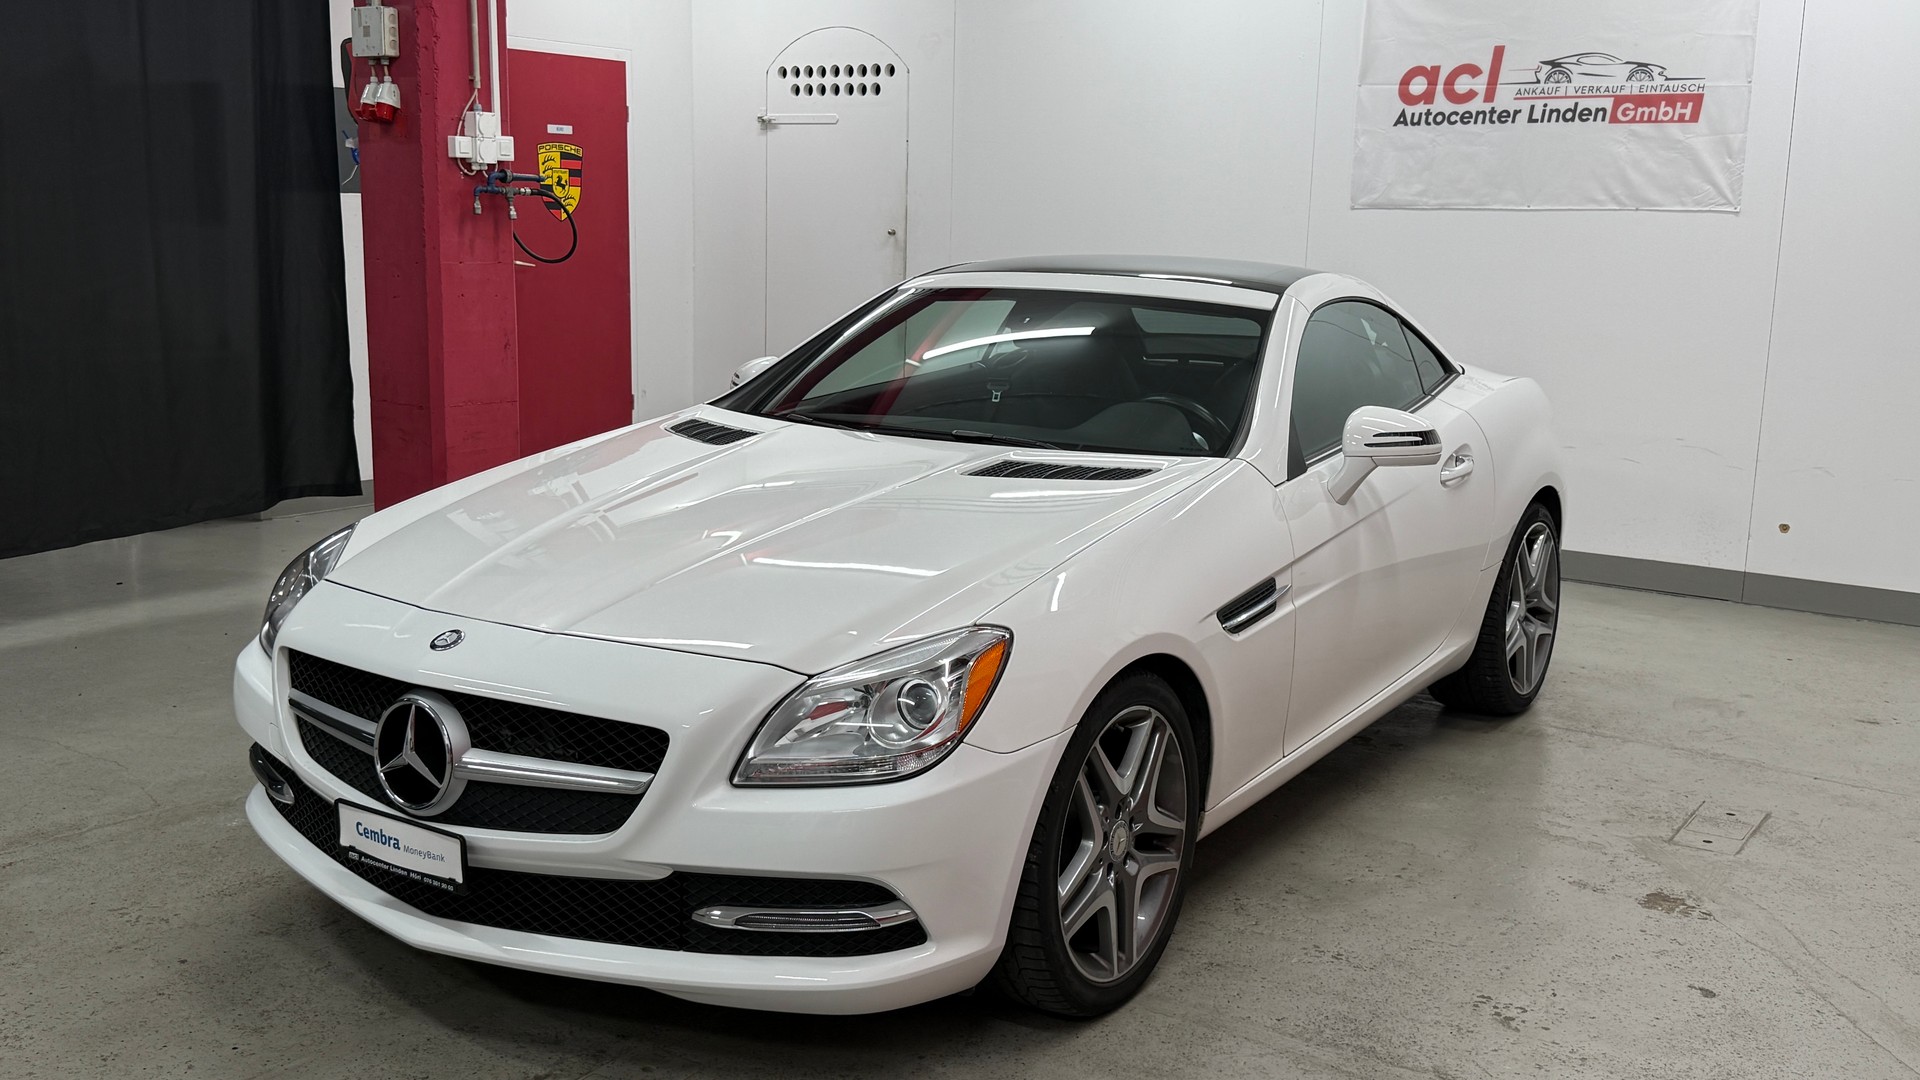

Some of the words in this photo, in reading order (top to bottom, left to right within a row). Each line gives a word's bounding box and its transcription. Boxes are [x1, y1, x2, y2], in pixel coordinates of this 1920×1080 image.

[1398, 45, 1505, 106] acl
[1515, 86, 1561, 96] ANKAUF
[1574, 84, 1625, 95] VERKAUF
[1639, 83, 1705, 94] EINTAUSCH
[1393, 106, 1522, 127] Autocenter
[1527, 101, 1608, 124] Linden
[1617, 102, 1693, 121] GmbH
[538, 144, 582, 155] PORSCHE
[356, 821, 400, 850] Cembra
[403, 845, 445, 862] MoneyBank
